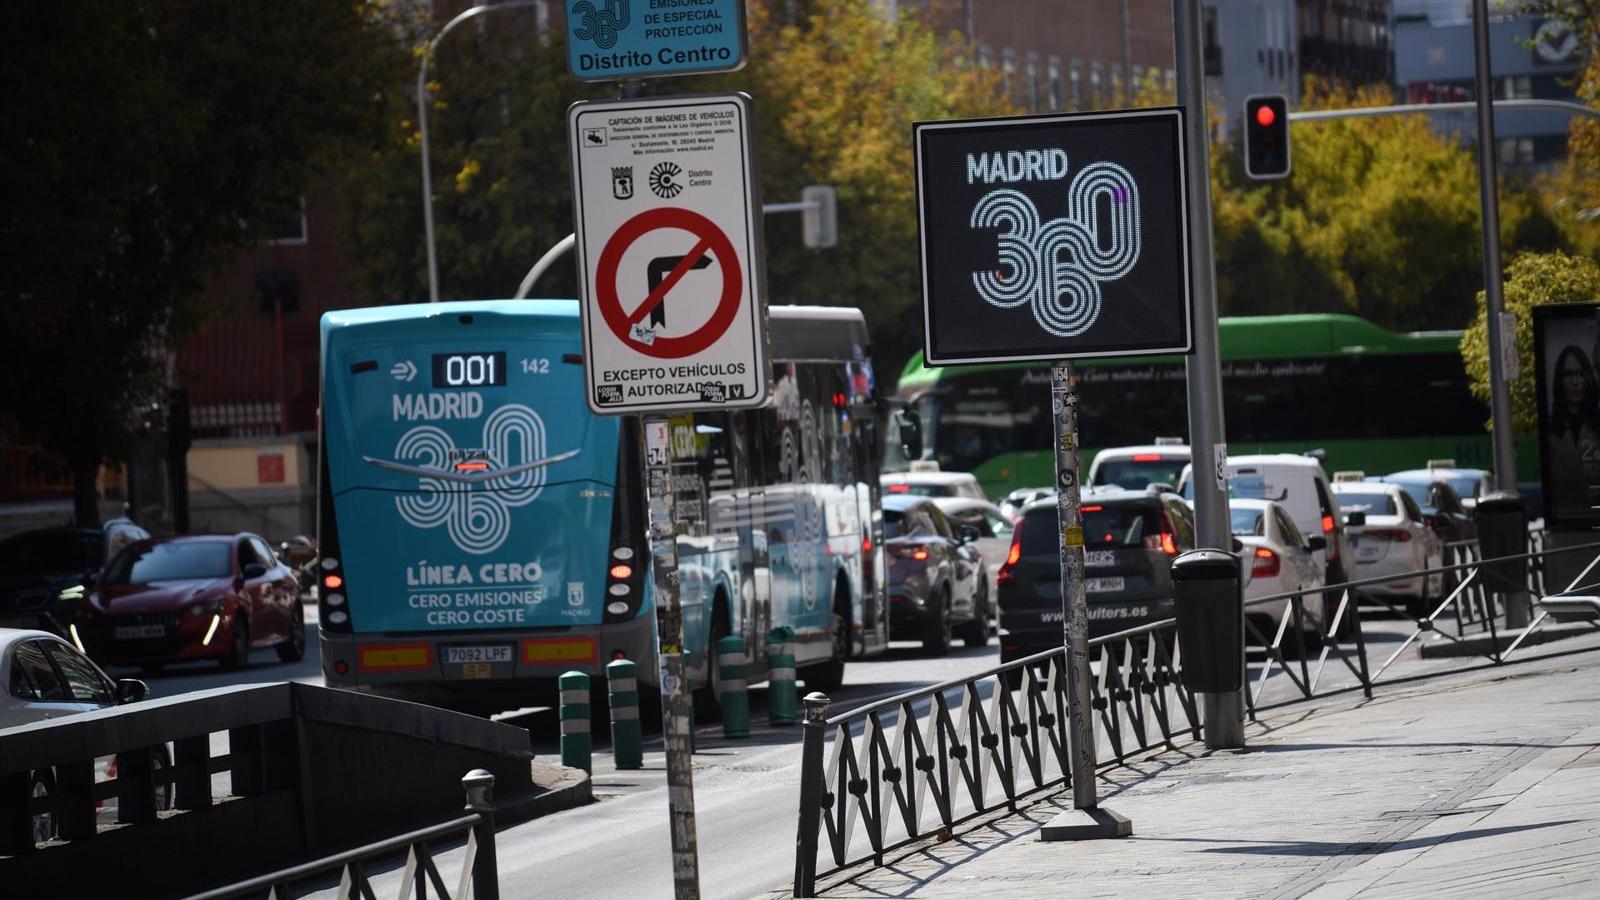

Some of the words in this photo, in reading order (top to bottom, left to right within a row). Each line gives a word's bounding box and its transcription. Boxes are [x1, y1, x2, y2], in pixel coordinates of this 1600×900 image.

[644, 14, 660, 25] DE
[664, 9, 722, 23] ESPECIAL
[645, 22, 723, 39] PROTECCIÓN
[579, 51, 653, 71] Distrito
[658, 45, 731, 65] Centro
[608, 116, 643, 127] CAPTACIÓN
[644, 115, 653, 124] DE
[655, 112, 687, 123] IMÁGENES
[689, 112, 698, 121] DE
[699, 109, 735, 119] VEHÍCULOS
[698, 136, 715, 144] Madrid
[688, 169, 713, 178] Distrito
[967, 148, 1068, 184] MADRID
[689, 178, 712, 187] Centro
[970, 161, 1142, 337] 360
[446, 355, 496, 386] 001
[520, 358, 550, 374] 142
[603, 367, 666, 383] EXCEPTO
[668, 361, 746, 378] VEHÍCULOS
[393, 392, 483, 421] MADRID
[394, 404, 547, 555] 360
[407, 560, 473, 586] LÍNEA
[480, 562, 542, 583] CERO
[409, 594, 451, 608] CERO
[455, 590, 541, 606] EMISIONES
[427, 610, 470, 625] CERO
[473, 608, 525, 623] COSTE
[450, 648, 481, 661] 7092
[485, 647, 510, 660] LPF
